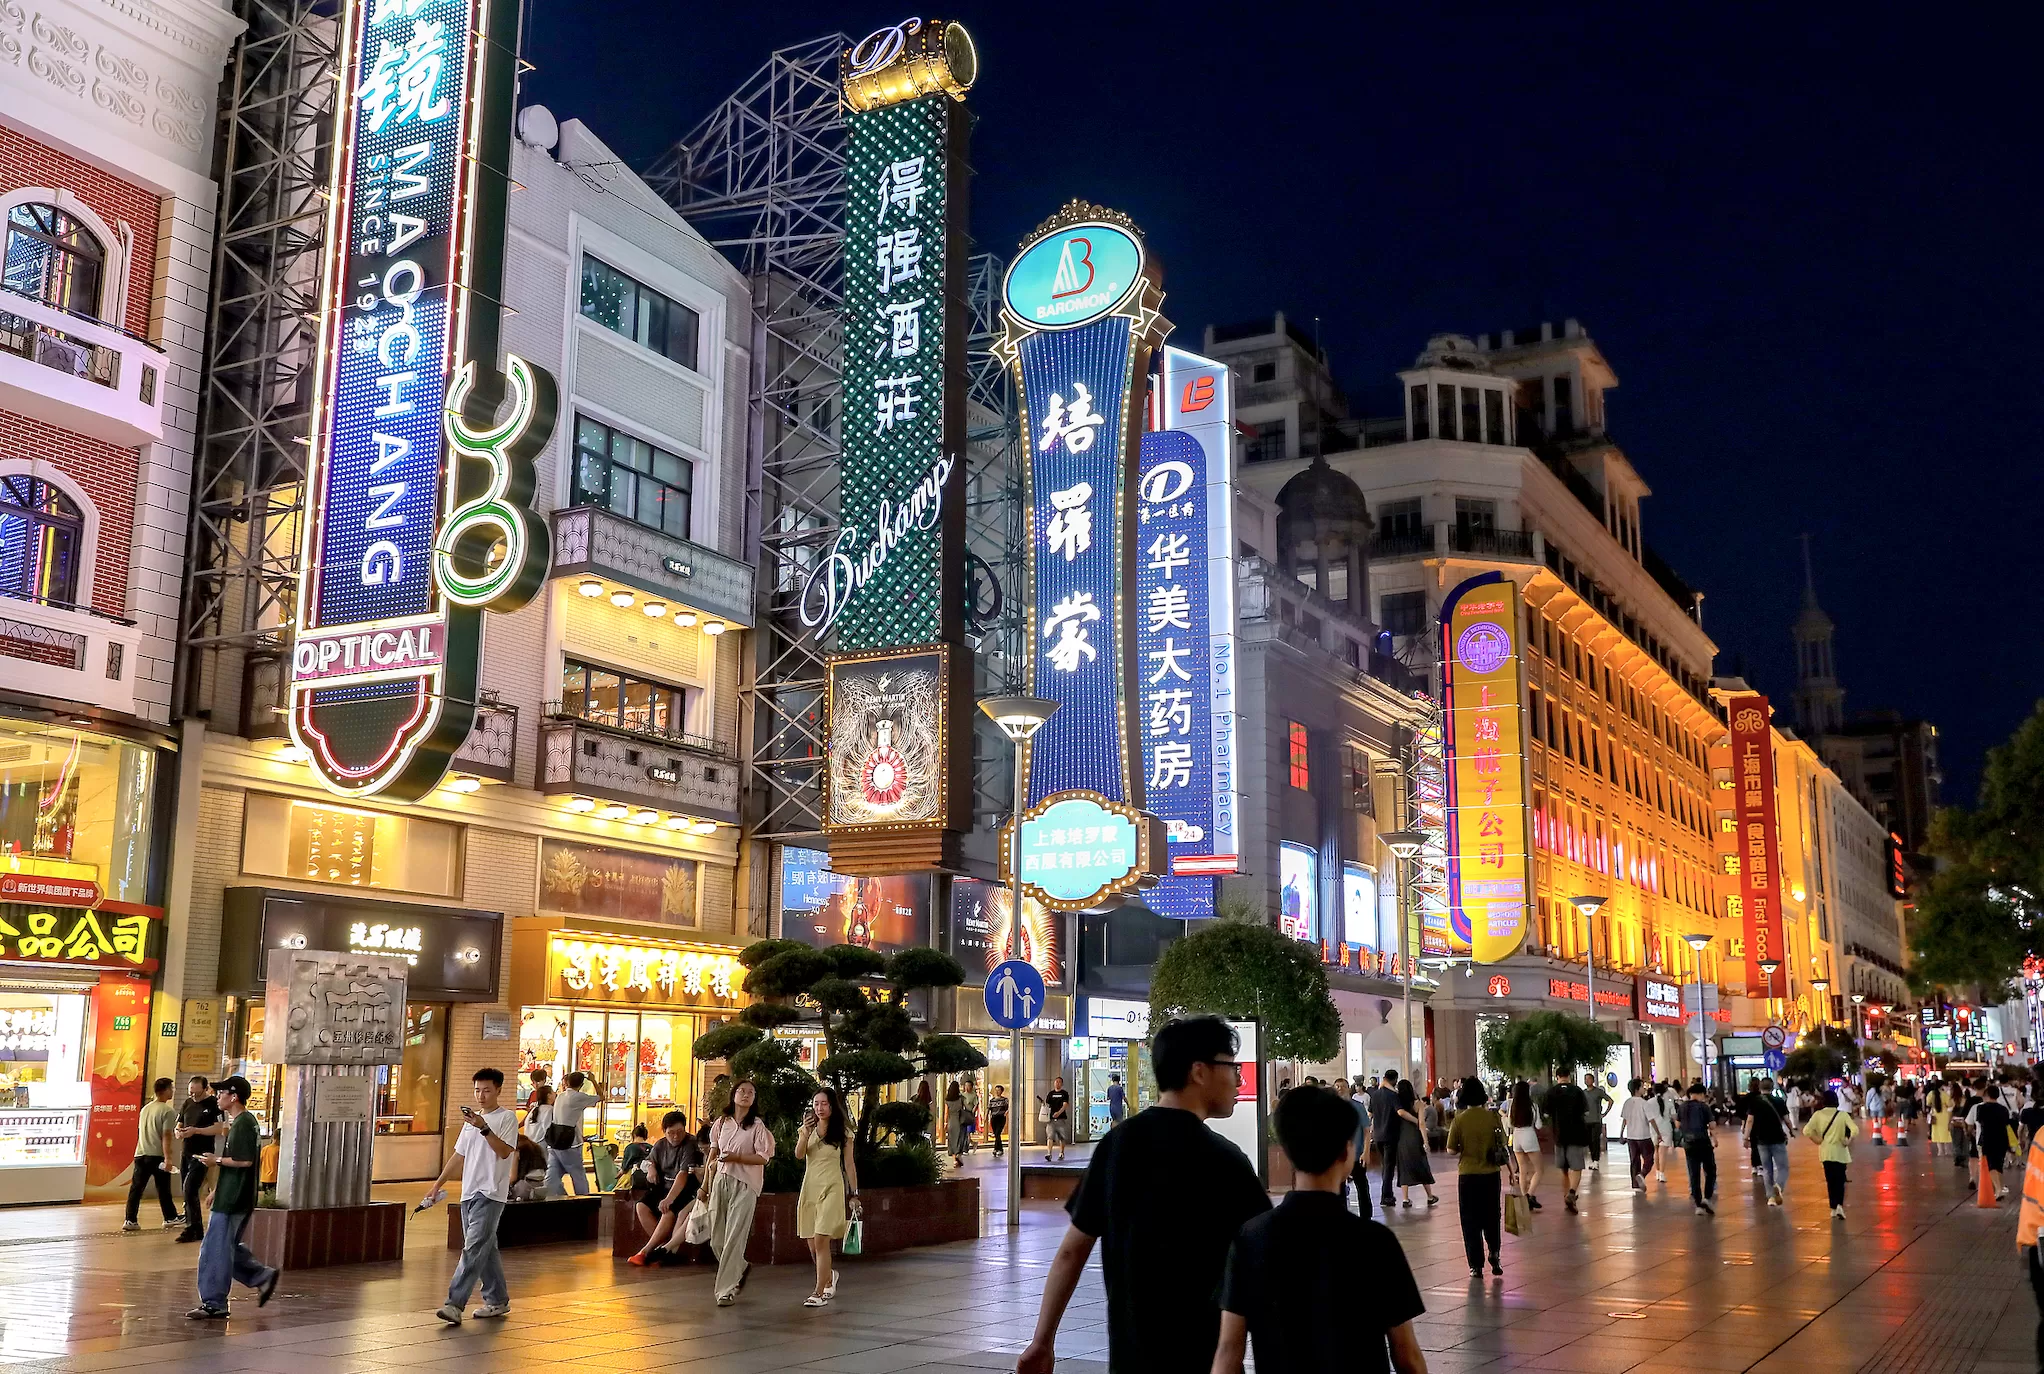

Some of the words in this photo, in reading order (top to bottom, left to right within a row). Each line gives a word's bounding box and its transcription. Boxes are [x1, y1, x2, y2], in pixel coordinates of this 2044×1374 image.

[358, 0, 451, 135] 镜
[361, 154, 388, 257] SINCE
[352, 271, 381, 353] 1923
[1036, 291, 1111, 319] BAROMON
[361, 140, 434, 587] MAOCHANG
[1141, 501, 1195, 525] 第一医药
[799, 452, 956, 641] Duchamp
[296, 627, 436, 675] OPTICAL
[1147, 533, 1194, 789] 华美大药房
[1214, 643, 1231, 699] No.1
[1215, 713, 1233, 836] Pharmacy
[1472, 685, 1504, 869] 上海帐子公司
[1743, 742, 1768, 889] 上海市第一食品商店
[1033, 826, 1118, 847] 上海培罗蒙
[1024, 848, 1126, 871] 西服有限公司
[18, 882, 94, 898] 新世界集团旗下品牌
[803, 893, 829, 907] Hennessy
[1488, 919, 1518, 927] ARTICLES
[1754, 898, 1767, 924] First
[115, 1017, 130, 1026] 766
[196, 1002, 209, 1011] 762
[163, 1023, 176, 1032] 762
